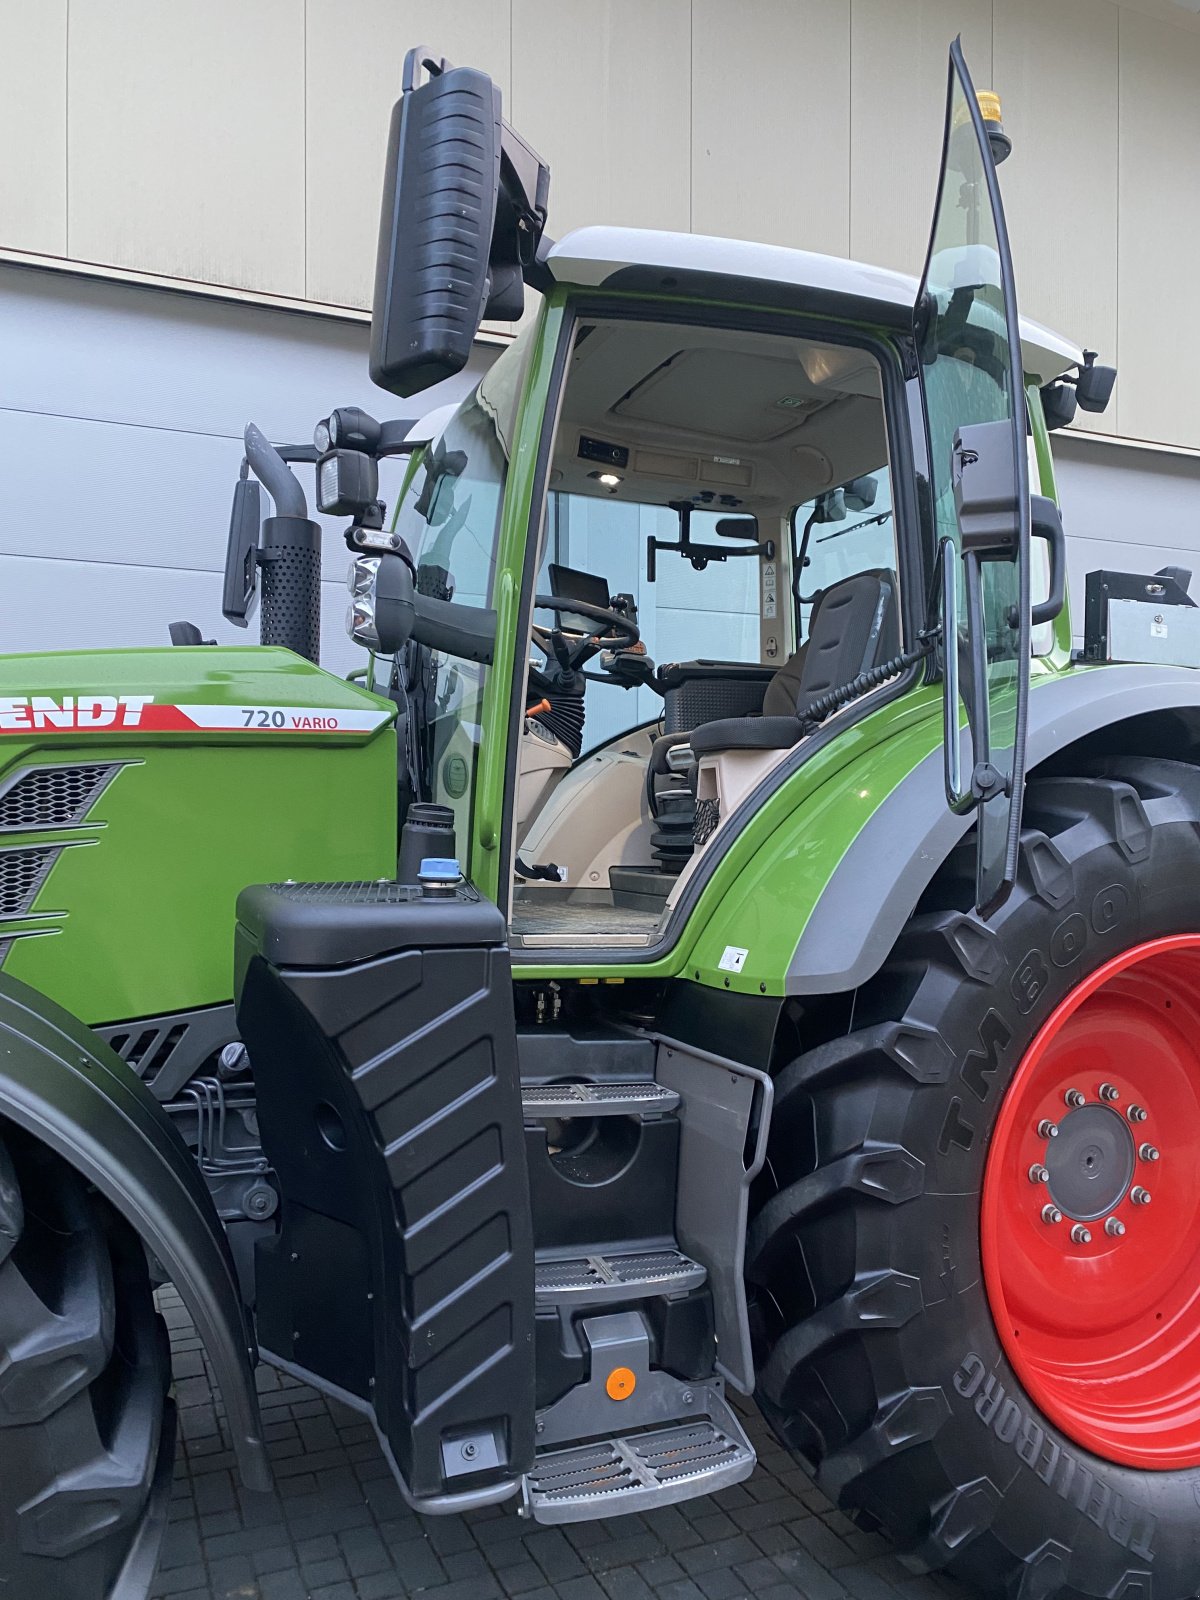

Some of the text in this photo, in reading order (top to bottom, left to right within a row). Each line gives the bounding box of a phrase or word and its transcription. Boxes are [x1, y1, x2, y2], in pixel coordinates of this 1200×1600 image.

[241, 709, 338, 729] 720 VARIO
[937, 883, 1131, 1154] TM 800
[952, 1352, 1158, 1563] TRELLEBORG
